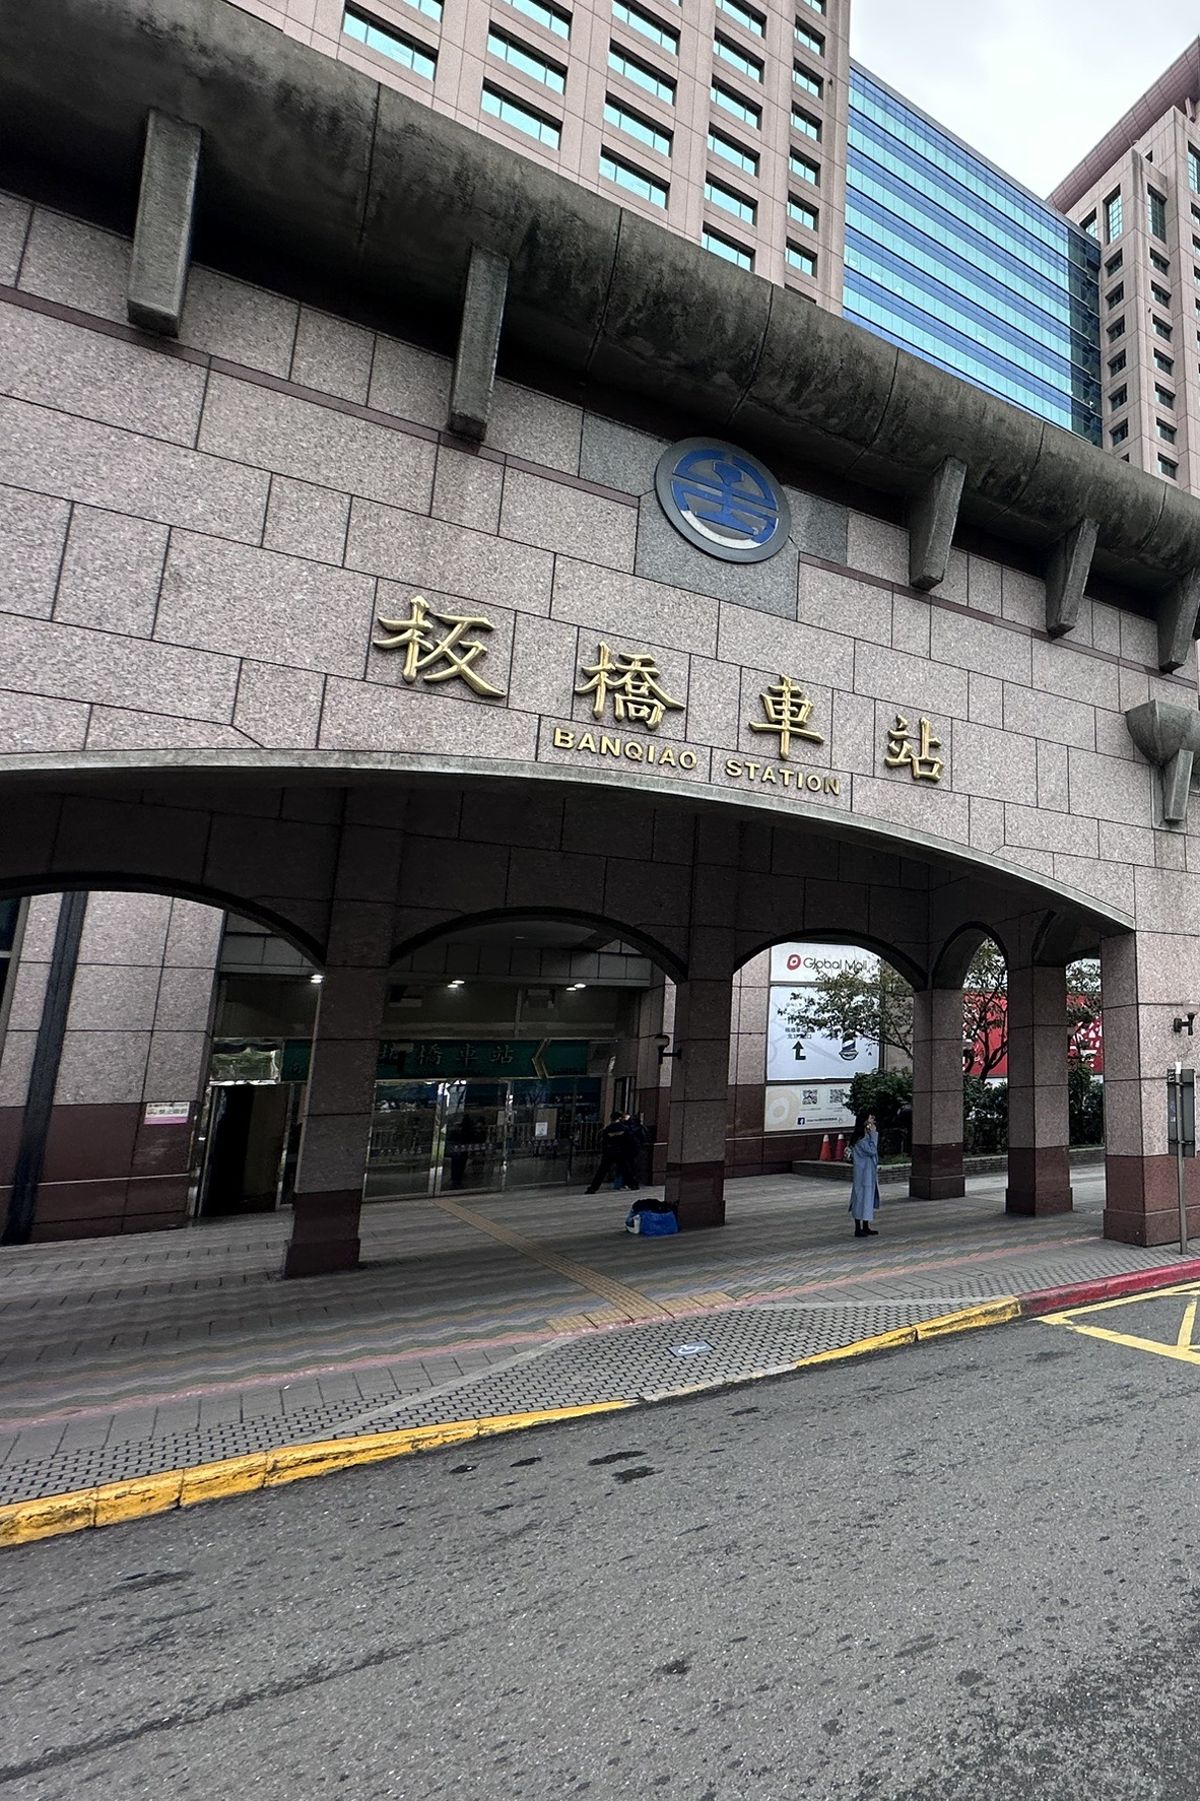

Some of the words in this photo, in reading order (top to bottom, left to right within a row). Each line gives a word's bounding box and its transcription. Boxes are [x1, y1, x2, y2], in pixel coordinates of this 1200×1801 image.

[373, 595, 944, 783] 板橋車站
[553, 726, 698, 772] BANQIAO
[725, 758, 841, 796] STATION
[803, 957, 842, 970] Global
